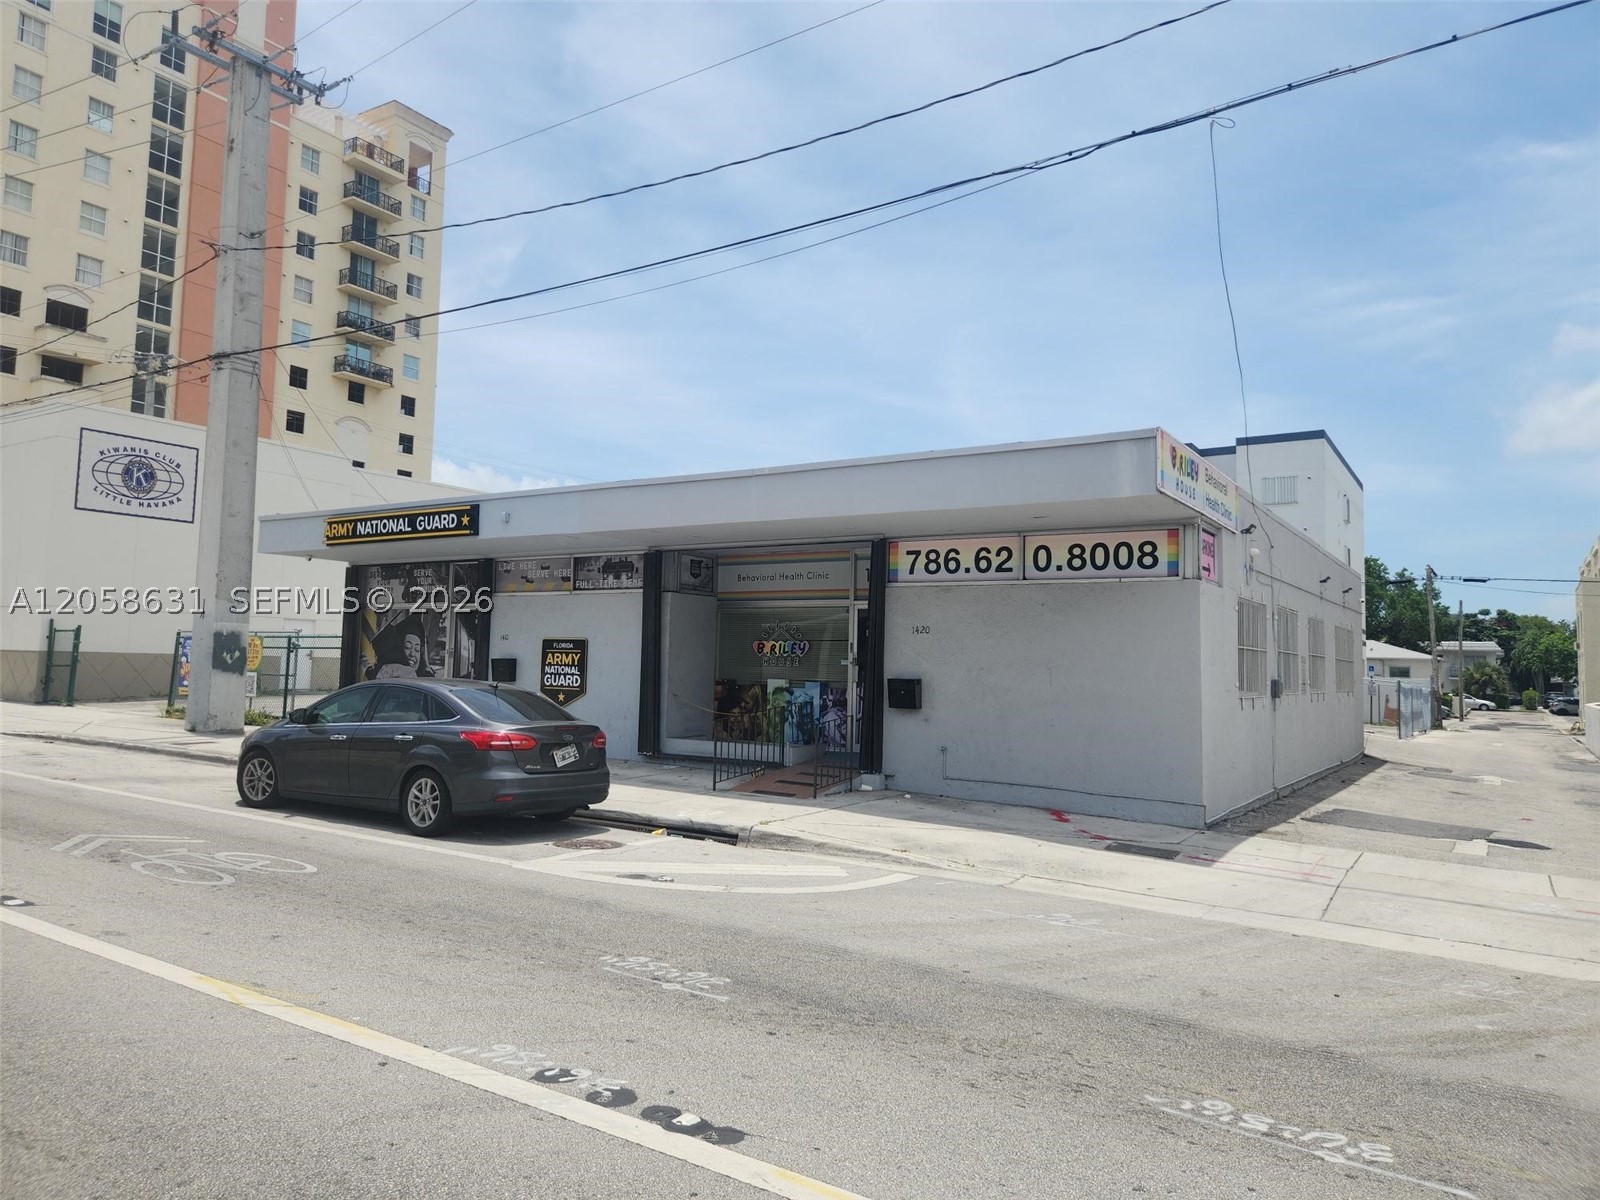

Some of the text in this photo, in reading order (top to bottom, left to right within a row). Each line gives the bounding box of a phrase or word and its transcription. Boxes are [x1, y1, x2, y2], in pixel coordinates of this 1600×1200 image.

[99, 446, 182, 470] KIWANIS CLUB
[93, 485, 182, 508] LITTLE HAVANA
[325, 514, 458, 538] ARMY NATIONAL GUARD
[905, 540, 1159, 575] 786.62 0.8008
[498, 561, 537, 571] LIVE HERE
[527, 568, 572, 578] SERVE HERE
[737, 570, 830, 582] Behavioral Health Clinic
[912, 625, 931, 635] 1420
[756, 641, 807, 655] B.RILEY
[545, 653, 581, 666] ARMY
[762, 657, 800, 667] HOUSE
[544, 665, 581, 675] NATIONAL
[544, 674, 581, 687] GUARD
